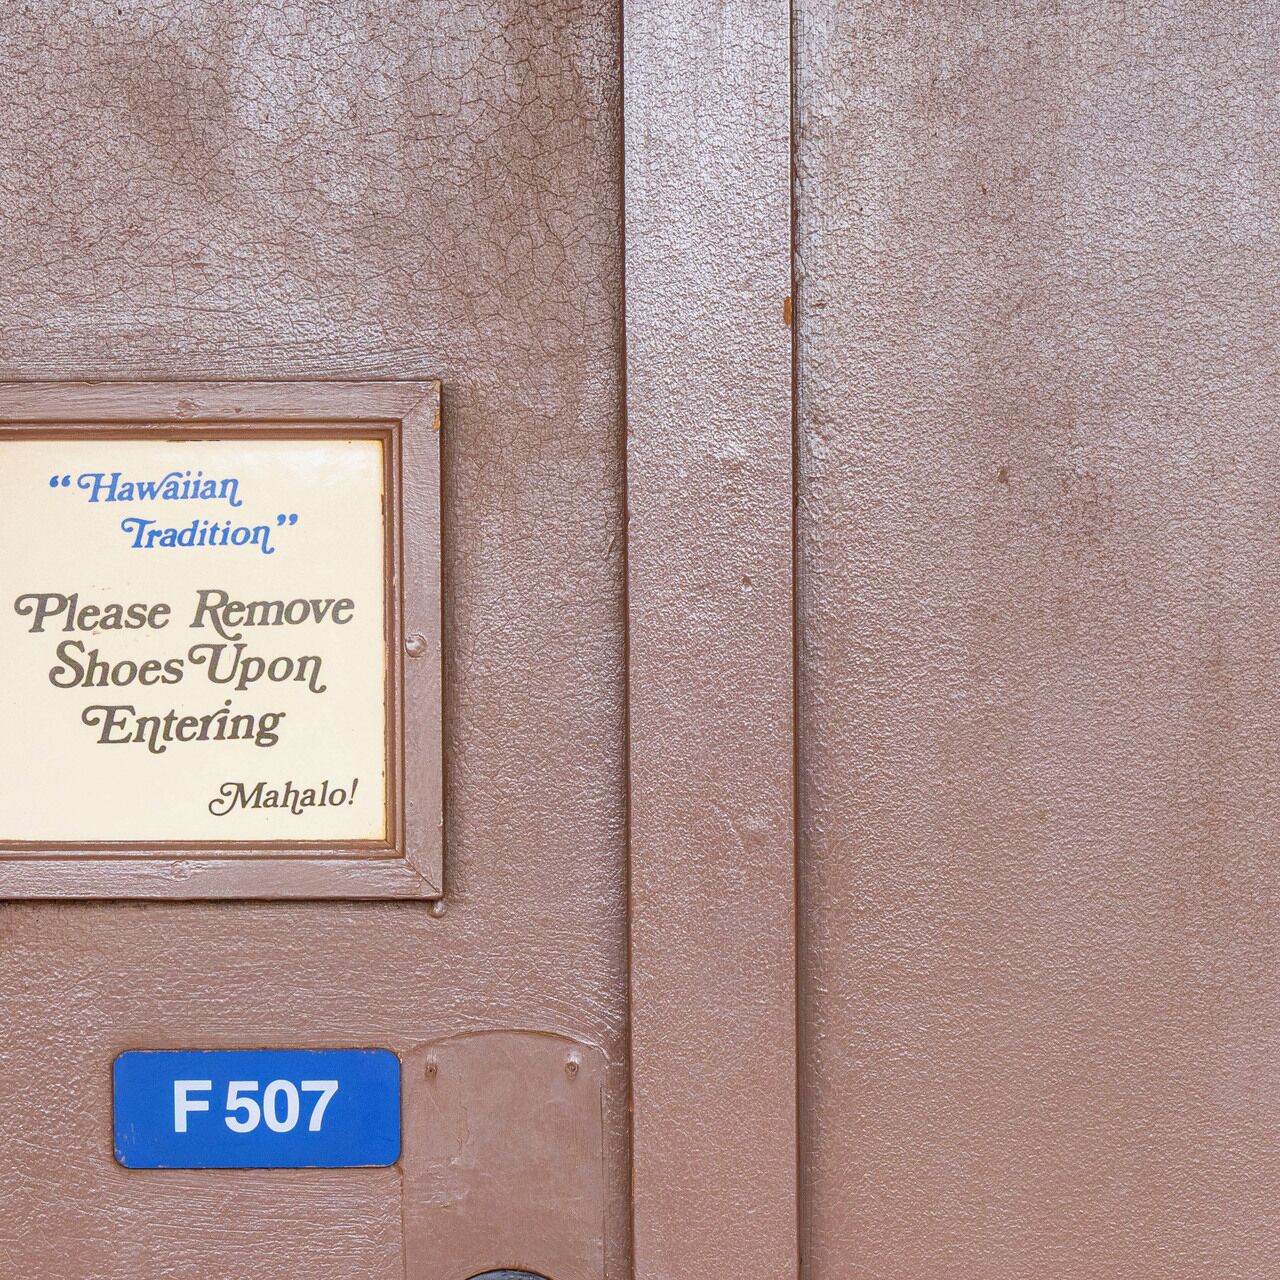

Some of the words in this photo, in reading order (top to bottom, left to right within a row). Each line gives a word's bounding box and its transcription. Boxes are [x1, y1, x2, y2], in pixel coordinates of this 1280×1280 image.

[14, 593, 171, 633] Please
[189, 590, 354, 641] Remove
[49, 640, 184, 688] Shoes
[188, 644, 327, 693] Upon
[82, 699, 286, 754] Entering
[208, 778, 358, 816] Mahalo!
[175, 1080, 211, 1132] F
[225, 1080, 338, 1132] 507
